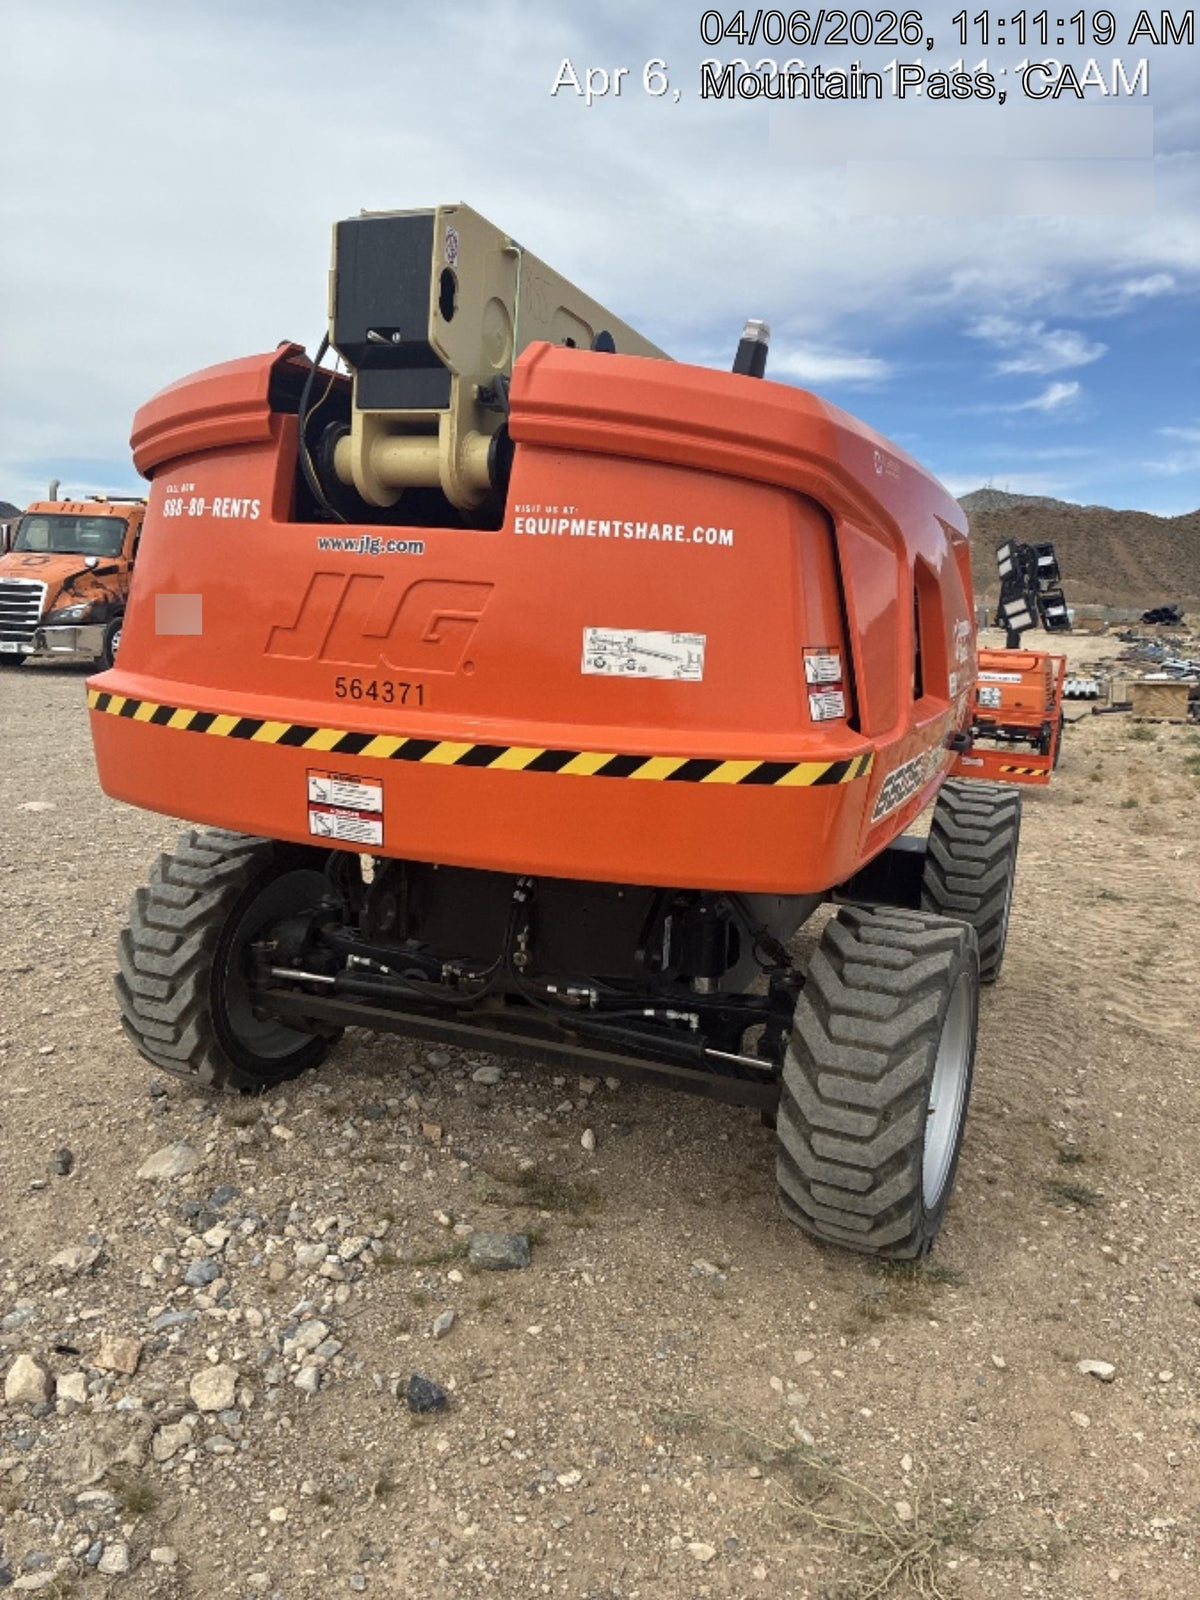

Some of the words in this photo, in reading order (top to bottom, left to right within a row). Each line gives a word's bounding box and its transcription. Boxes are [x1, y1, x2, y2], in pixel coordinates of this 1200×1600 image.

[163, 497, 261, 520] 888-80-RENTS
[514, 517, 734, 546] EQUIPMENTSHARE.COM
[317, 536, 425, 555] www.jlg.com
[334, 676, 425, 706] 564371
